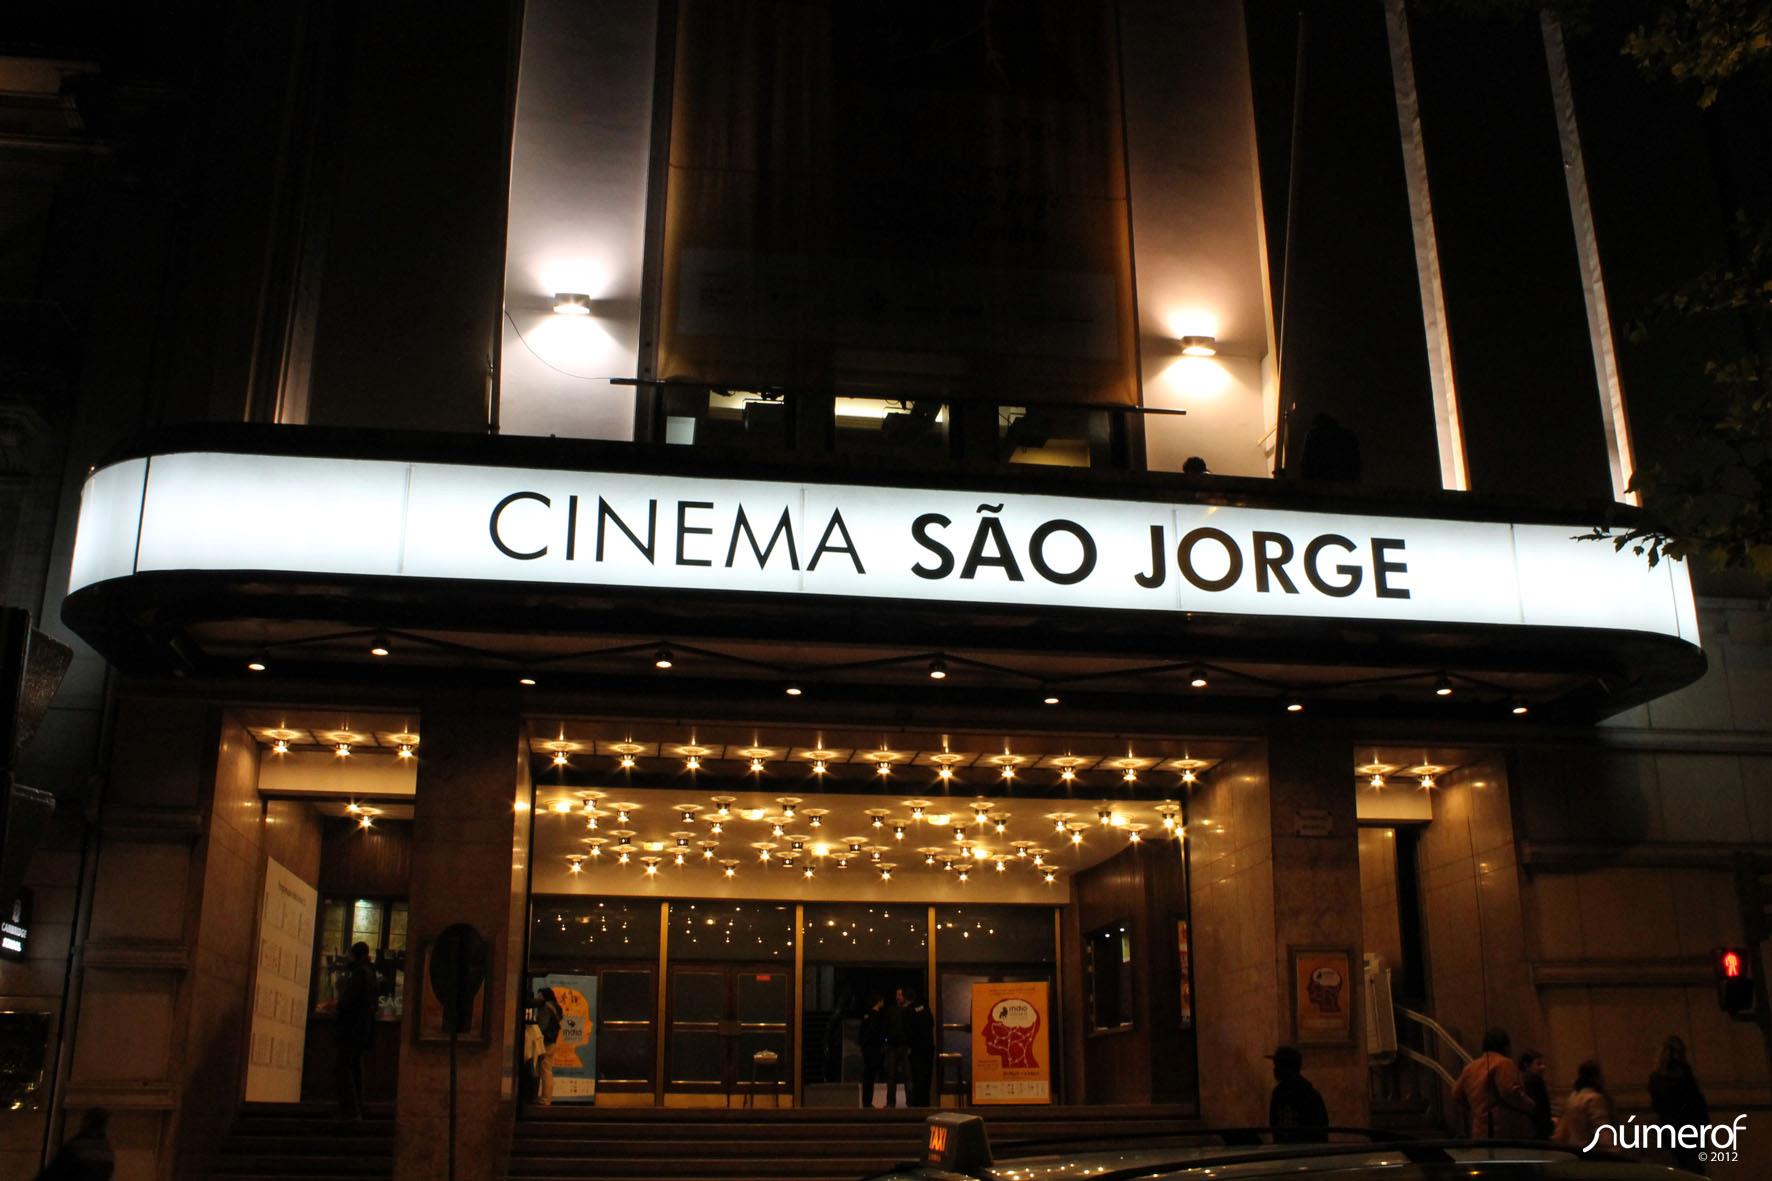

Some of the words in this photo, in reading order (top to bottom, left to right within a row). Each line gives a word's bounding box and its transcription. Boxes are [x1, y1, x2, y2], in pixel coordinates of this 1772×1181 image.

[489, 491, 866, 575] CINEMA
[911, 503, 1098, 586] SÃO
[1134, 525, 1411, 600] JORGE
[929, 1126, 948, 1152] TAXI
